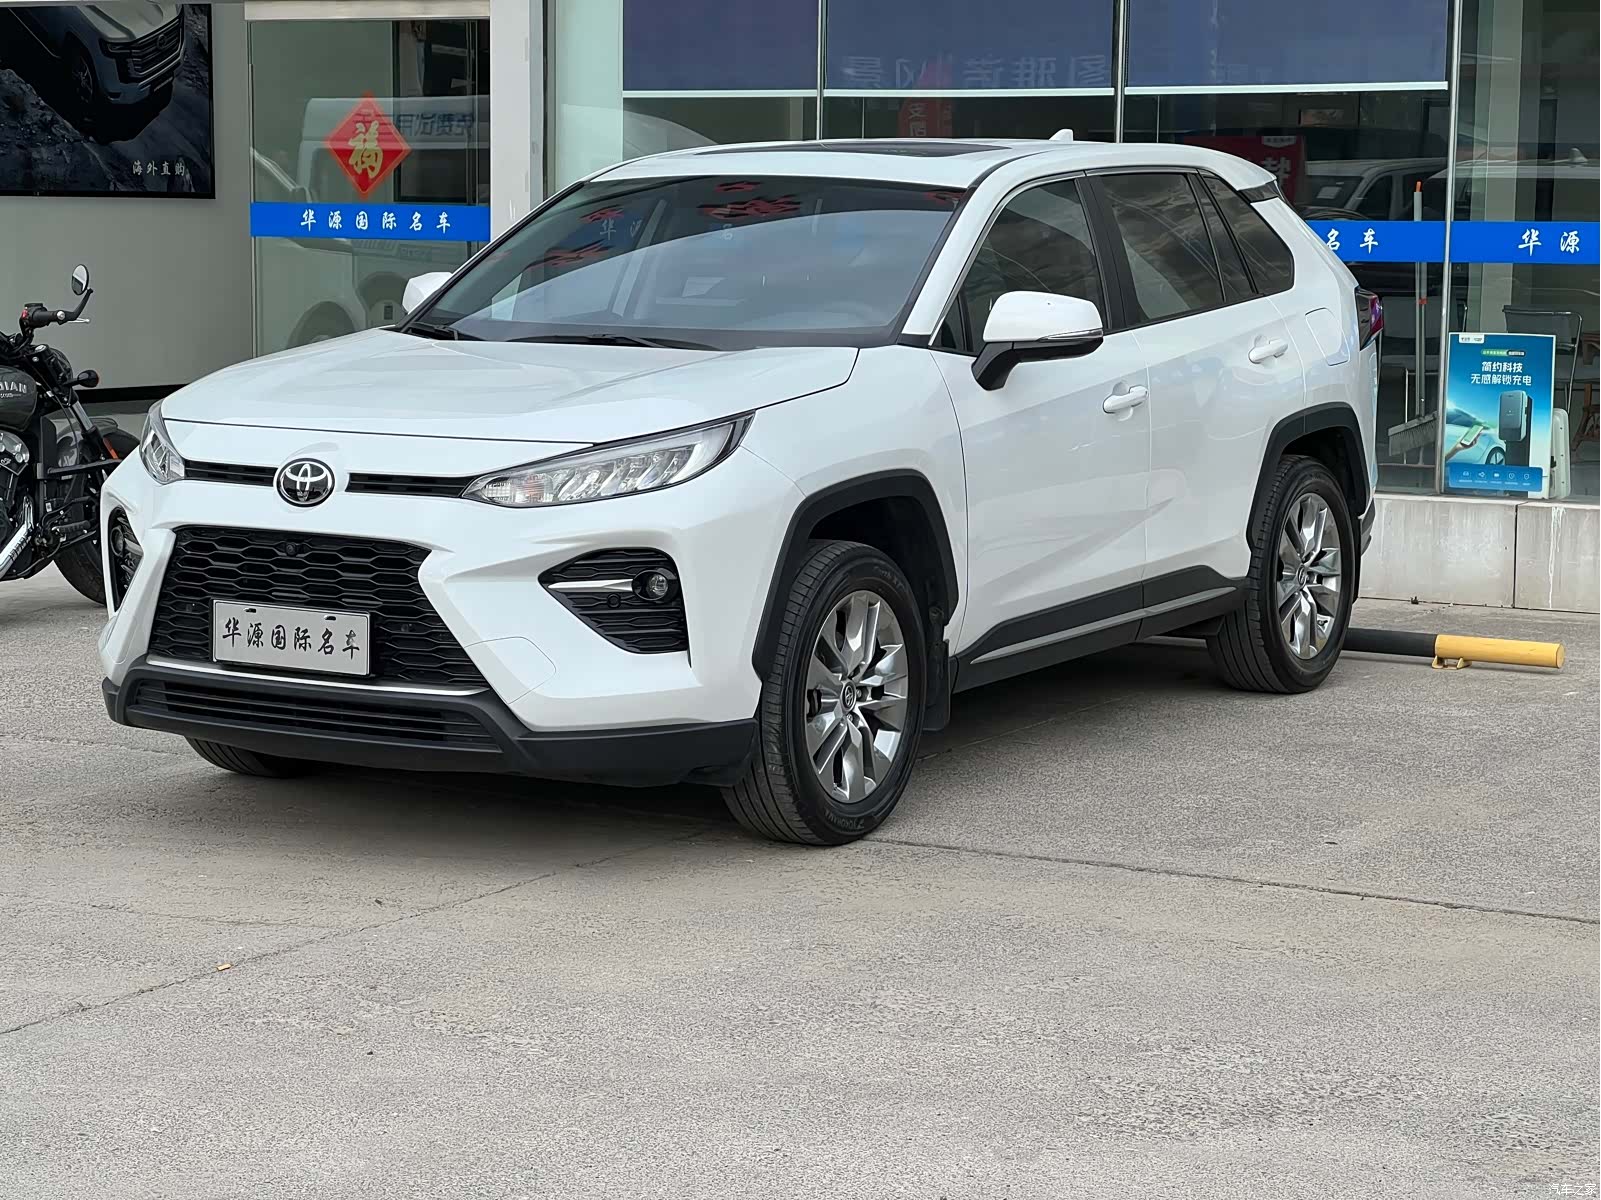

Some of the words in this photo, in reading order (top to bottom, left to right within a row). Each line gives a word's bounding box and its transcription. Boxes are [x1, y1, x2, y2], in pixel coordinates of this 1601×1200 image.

[348, 120, 384, 180] 福
[132, 160, 185, 176] 海外直购
[300, 208, 451, 234] 华源国际名车
[1326, 227, 1379, 254] 名车
[1518, 228, 1580, 257] 华源
[1470, 373, 1532, 386] 无感解锁充电
[1481, 361, 1523, 373] 简约科技
[222, 617, 360, 660] 华源国际名车
